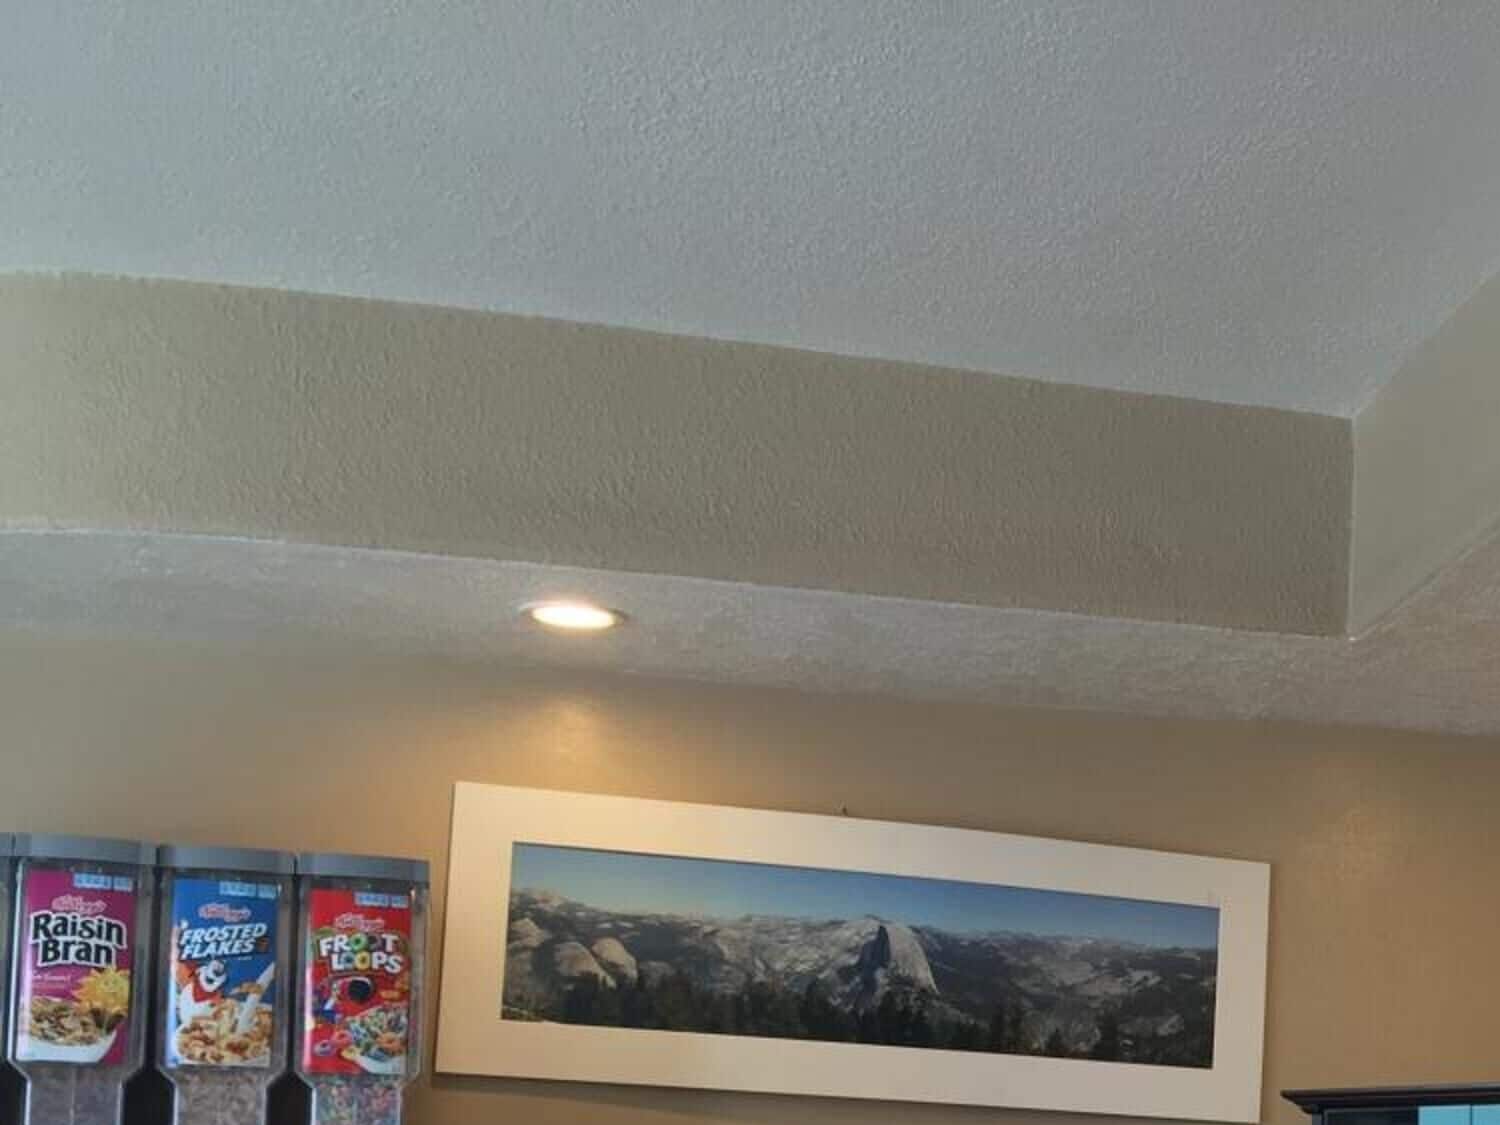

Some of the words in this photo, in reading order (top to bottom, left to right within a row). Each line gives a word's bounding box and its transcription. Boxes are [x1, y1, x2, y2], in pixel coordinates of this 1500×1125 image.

[31, 911, 125, 946] Raisin
[180, 923, 267, 946] FROSTED
[40, 938, 114, 965] Bran
[181, 938, 256, 960] FLAKES
[319, 932, 400, 957] FROOT
[331, 950, 404, 974] LOOPS
